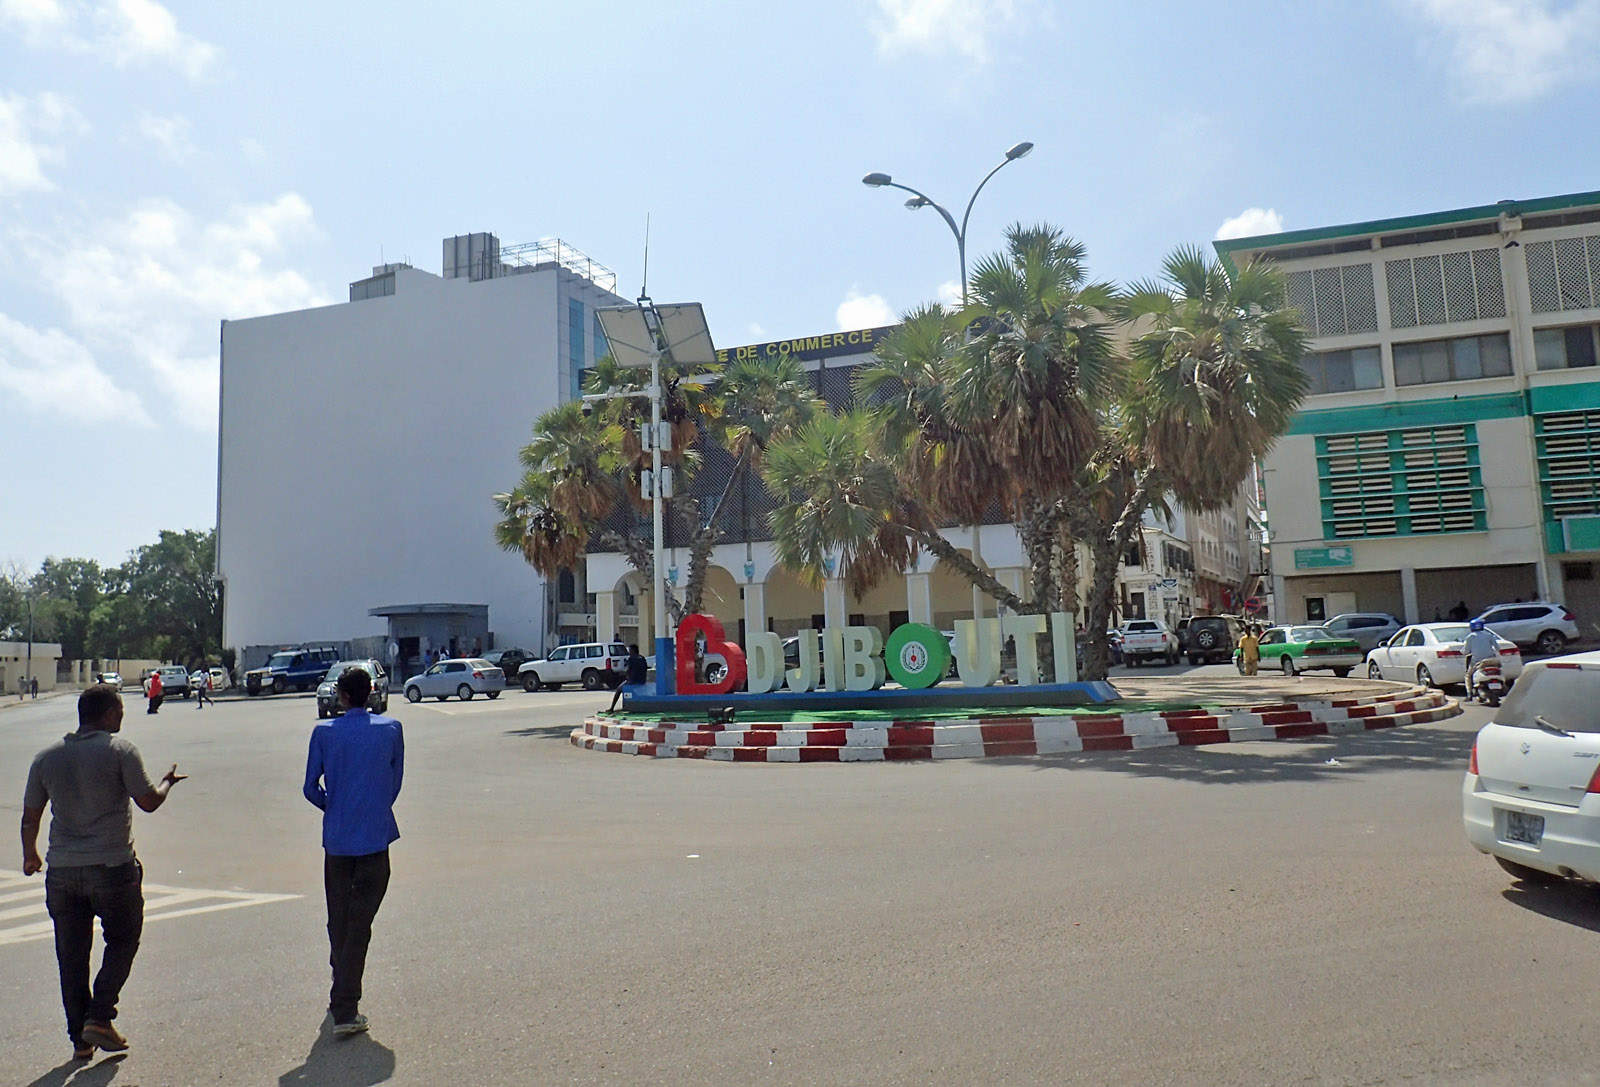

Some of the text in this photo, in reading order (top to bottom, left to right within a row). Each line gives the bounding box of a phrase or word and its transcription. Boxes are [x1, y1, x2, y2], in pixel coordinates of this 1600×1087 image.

[736, 345, 758, 360] DE
[766, 329, 873, 356] COMMERCE
[747, 612, 1077, 695] DJIBOUTI
